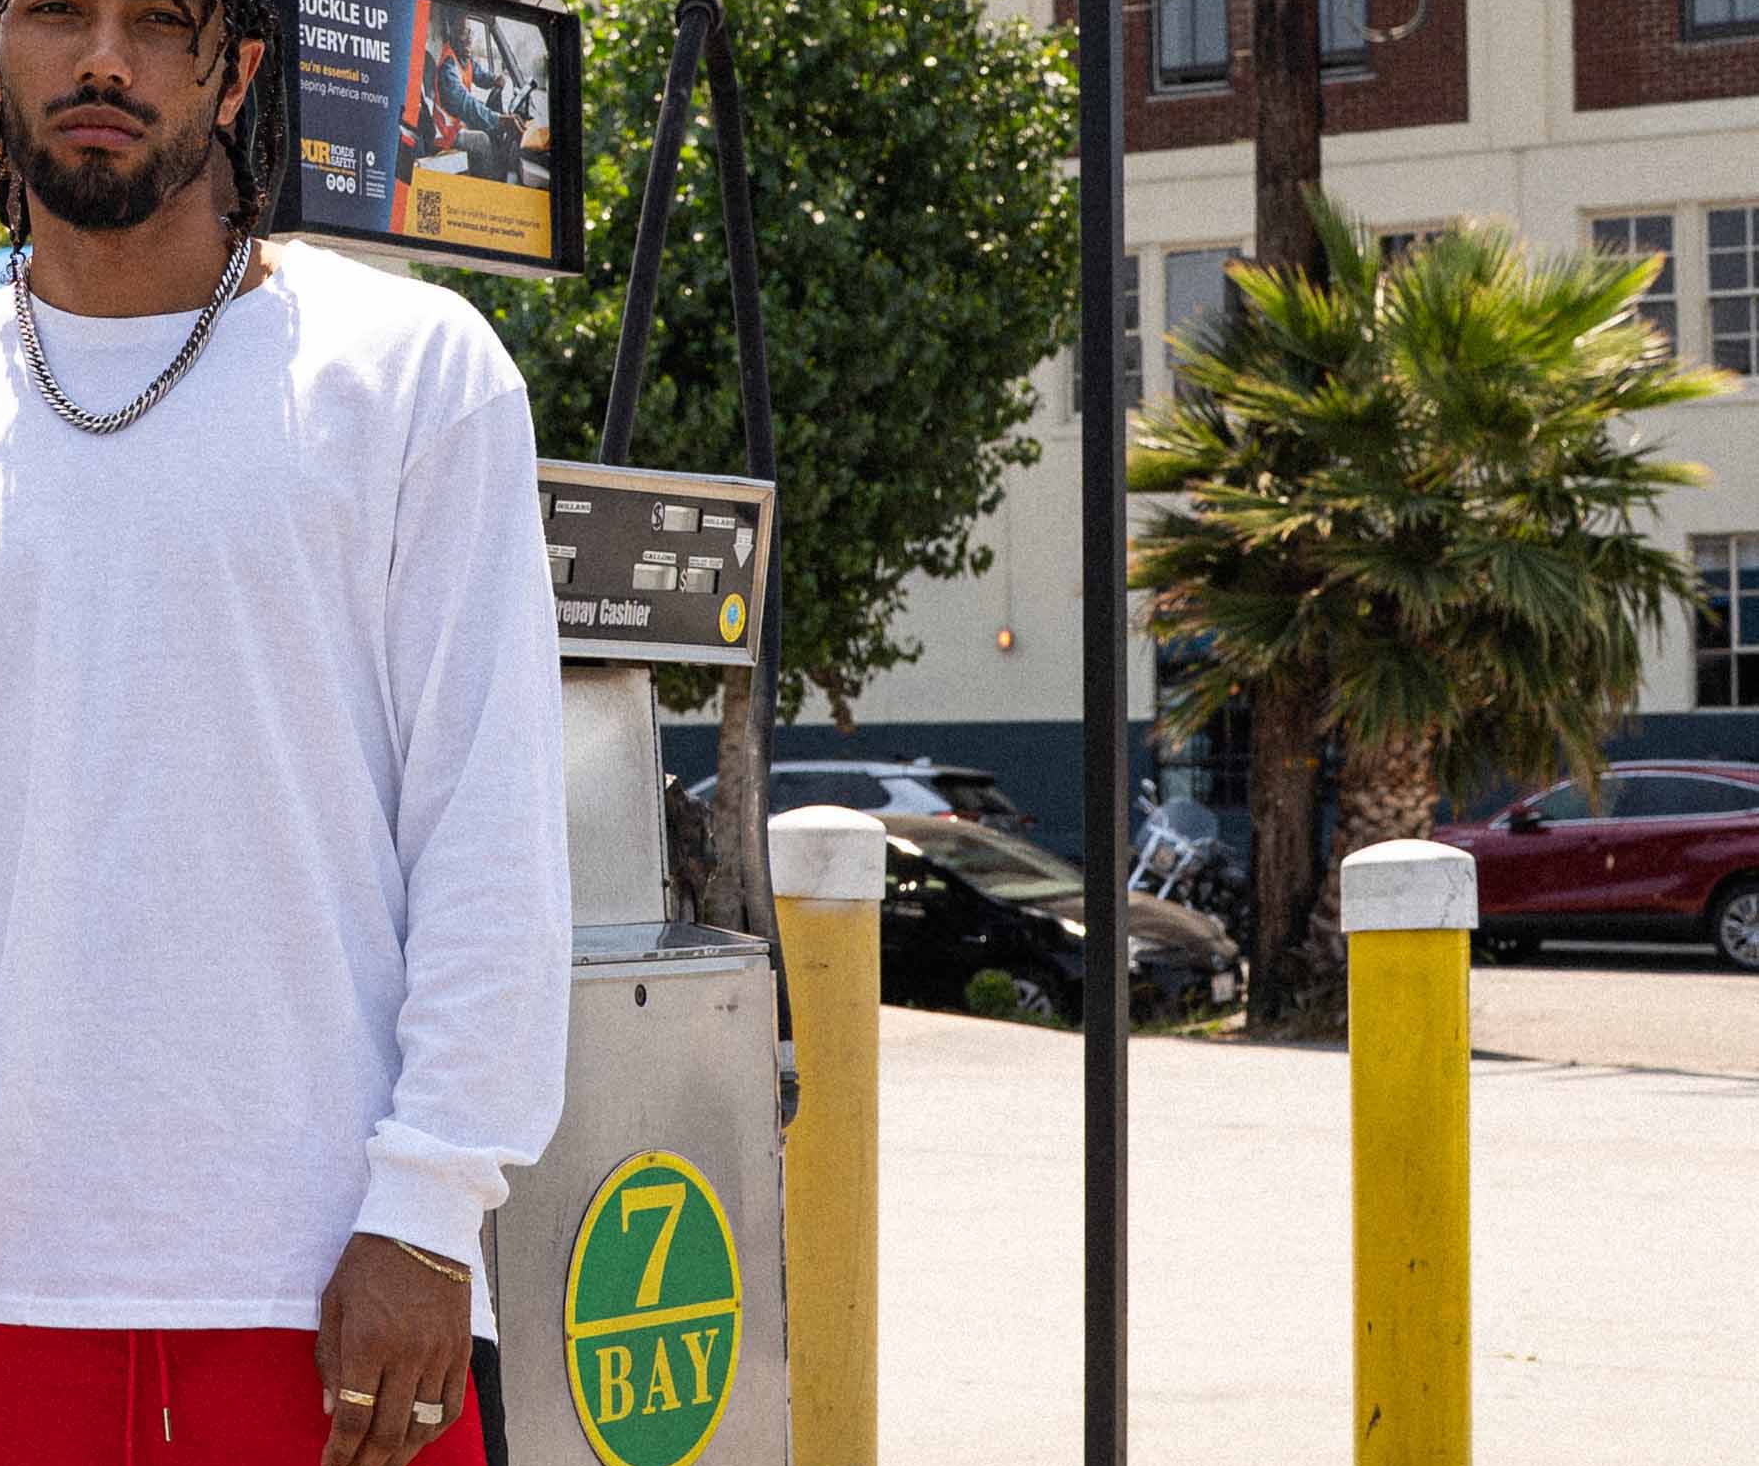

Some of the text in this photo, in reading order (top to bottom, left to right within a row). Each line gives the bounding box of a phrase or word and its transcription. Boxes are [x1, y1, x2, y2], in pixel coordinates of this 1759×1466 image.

[364, 6, 389, 30] UP
[350, 34, 390, 64] TIME
[299, 59, 321, 74] ou're
[360, 71, 370, 84] to
[328, 82, 360, 101] America
[360, 91, 390, 109] moving
[555, 596, 651, 627] repay Cashier
[620, 1182, 687, 1308] 7
[595, 1328, 720, 1425] BAY
